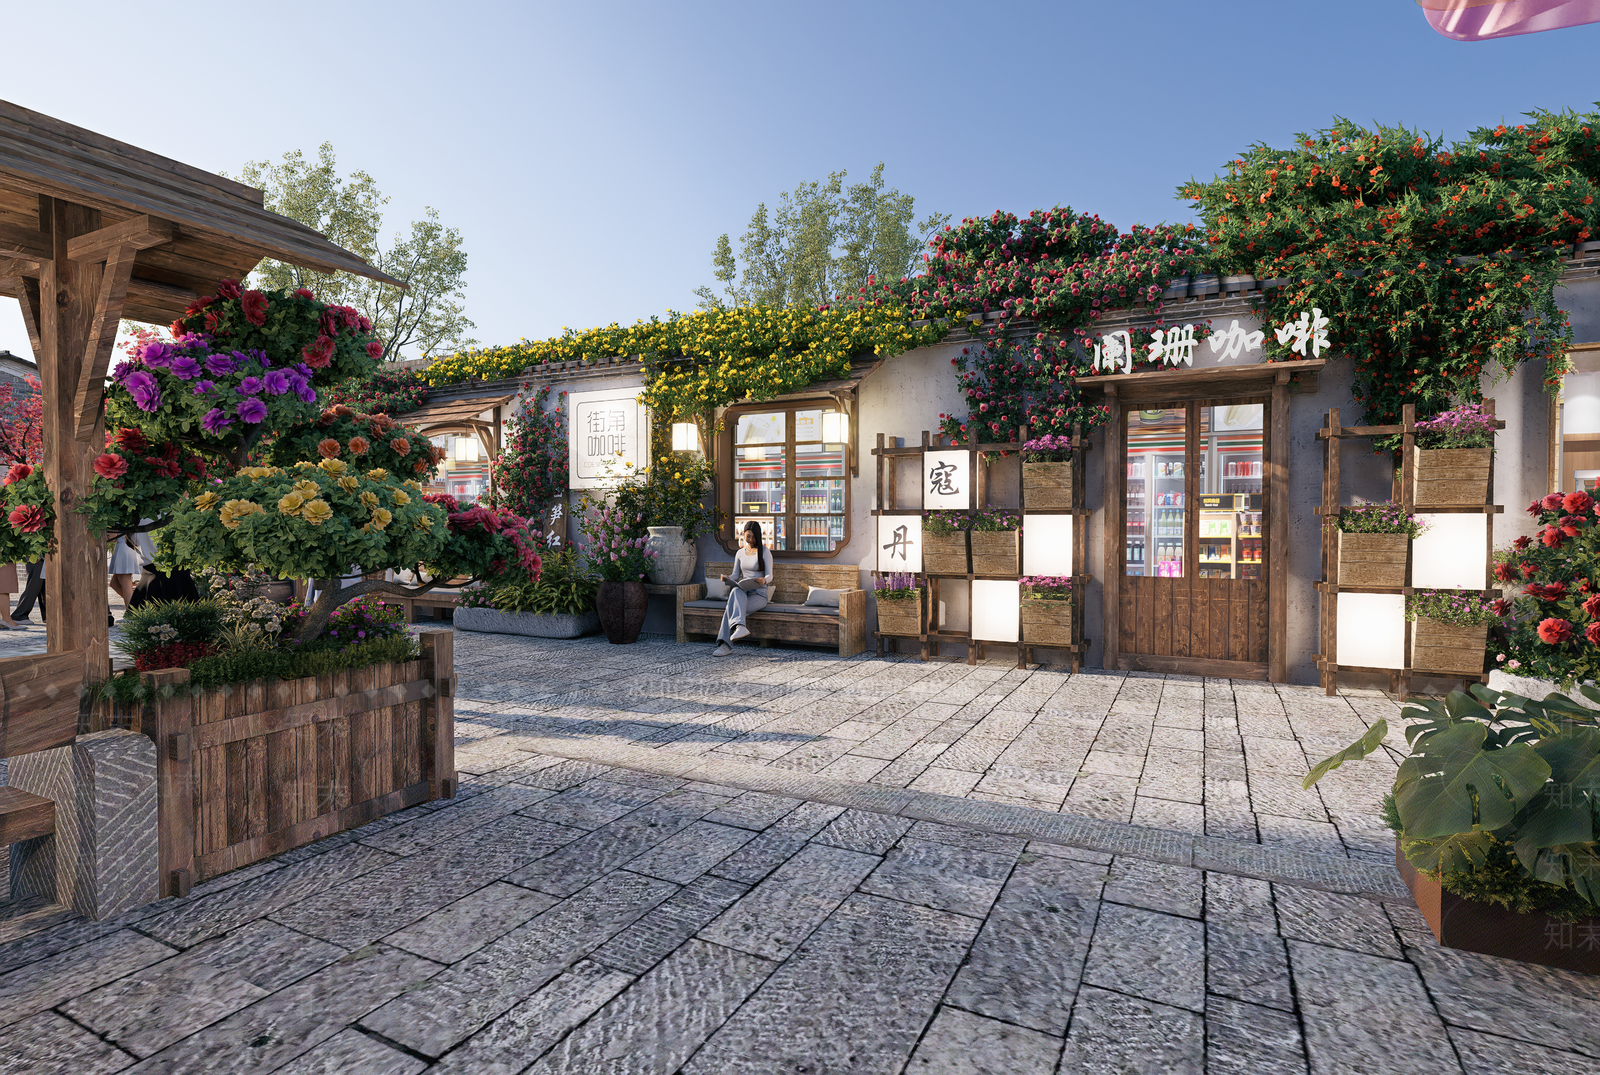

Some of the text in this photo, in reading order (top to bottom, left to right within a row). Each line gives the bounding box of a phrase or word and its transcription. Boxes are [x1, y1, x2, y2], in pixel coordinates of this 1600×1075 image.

[1093, 307, 1331, 374] 阑珊咖啡
[587, 410, 625, 433] 街角
[587, 434, 626, 457] 咖啡
[929, 460, 960, 496] 寇
[882, 524, 914, 561] 丹
